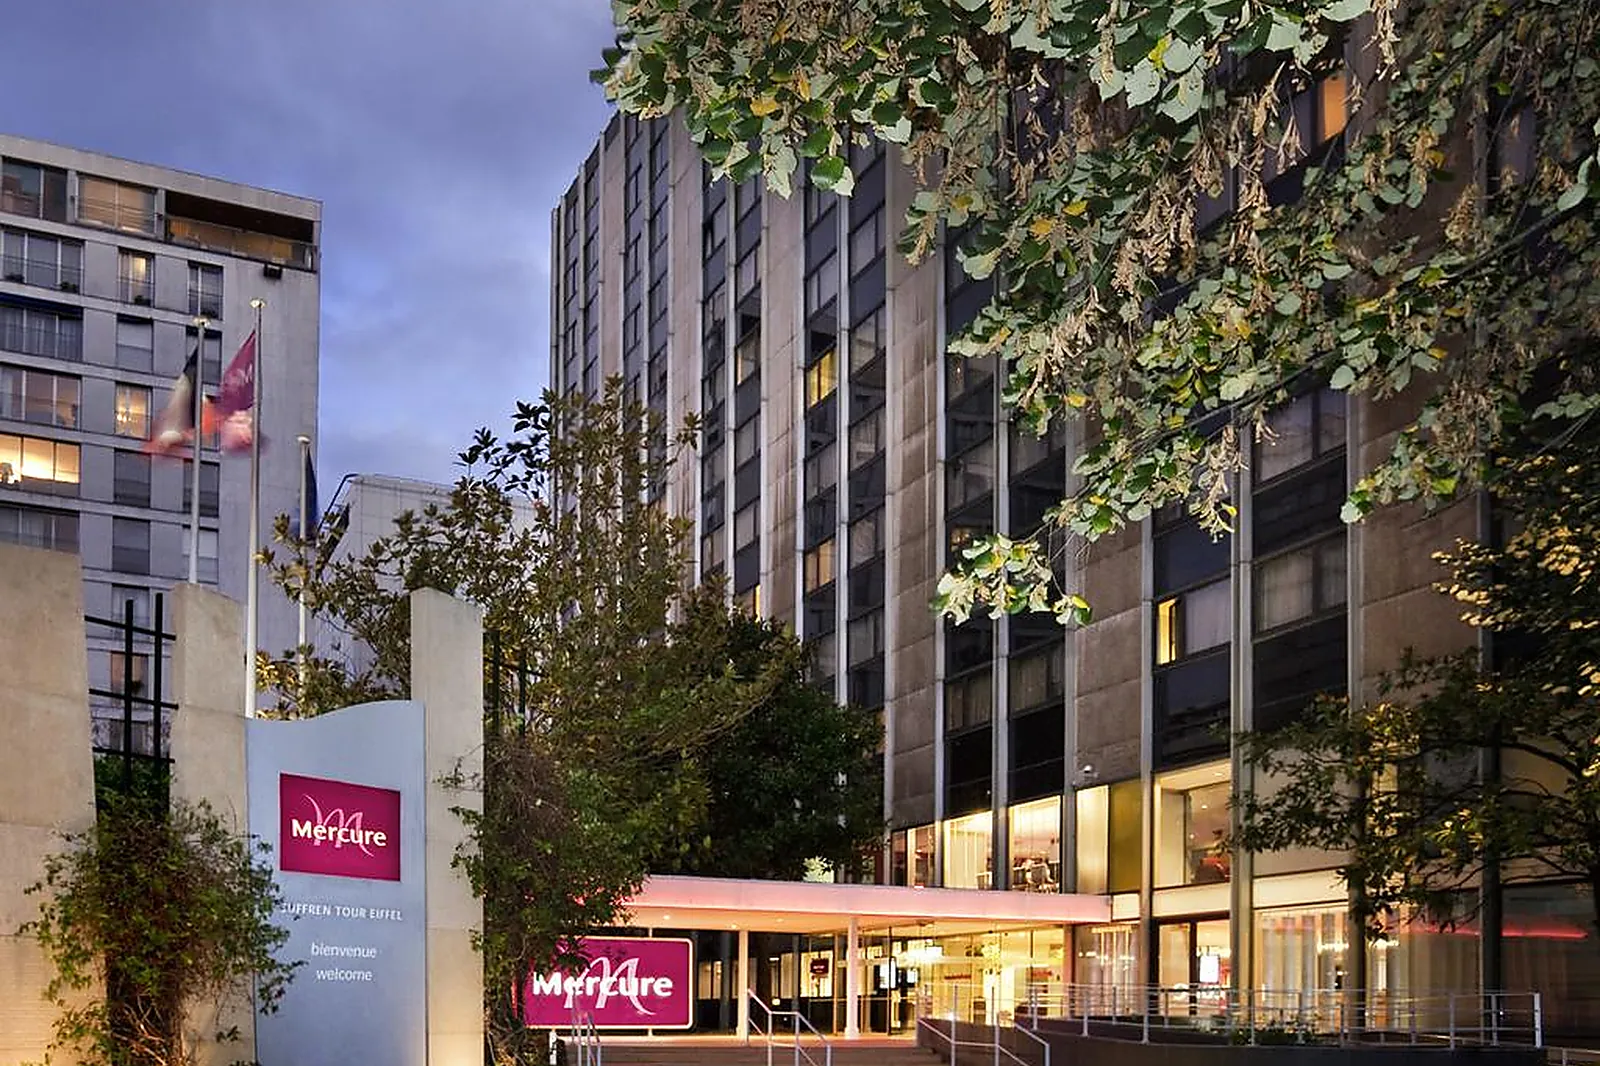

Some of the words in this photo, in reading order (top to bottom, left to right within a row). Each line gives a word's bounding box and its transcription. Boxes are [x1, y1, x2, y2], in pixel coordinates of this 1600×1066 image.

[291, 819, 387, 847] Mercure
[334, 905, 366, 919] TOUR
[369, 908, 403, 920] EIFFEL
[311, 942, 377, 958] bienvenue
[316, 968, 373, 981] welcome
[532, 971, 673, 997] Mercure
